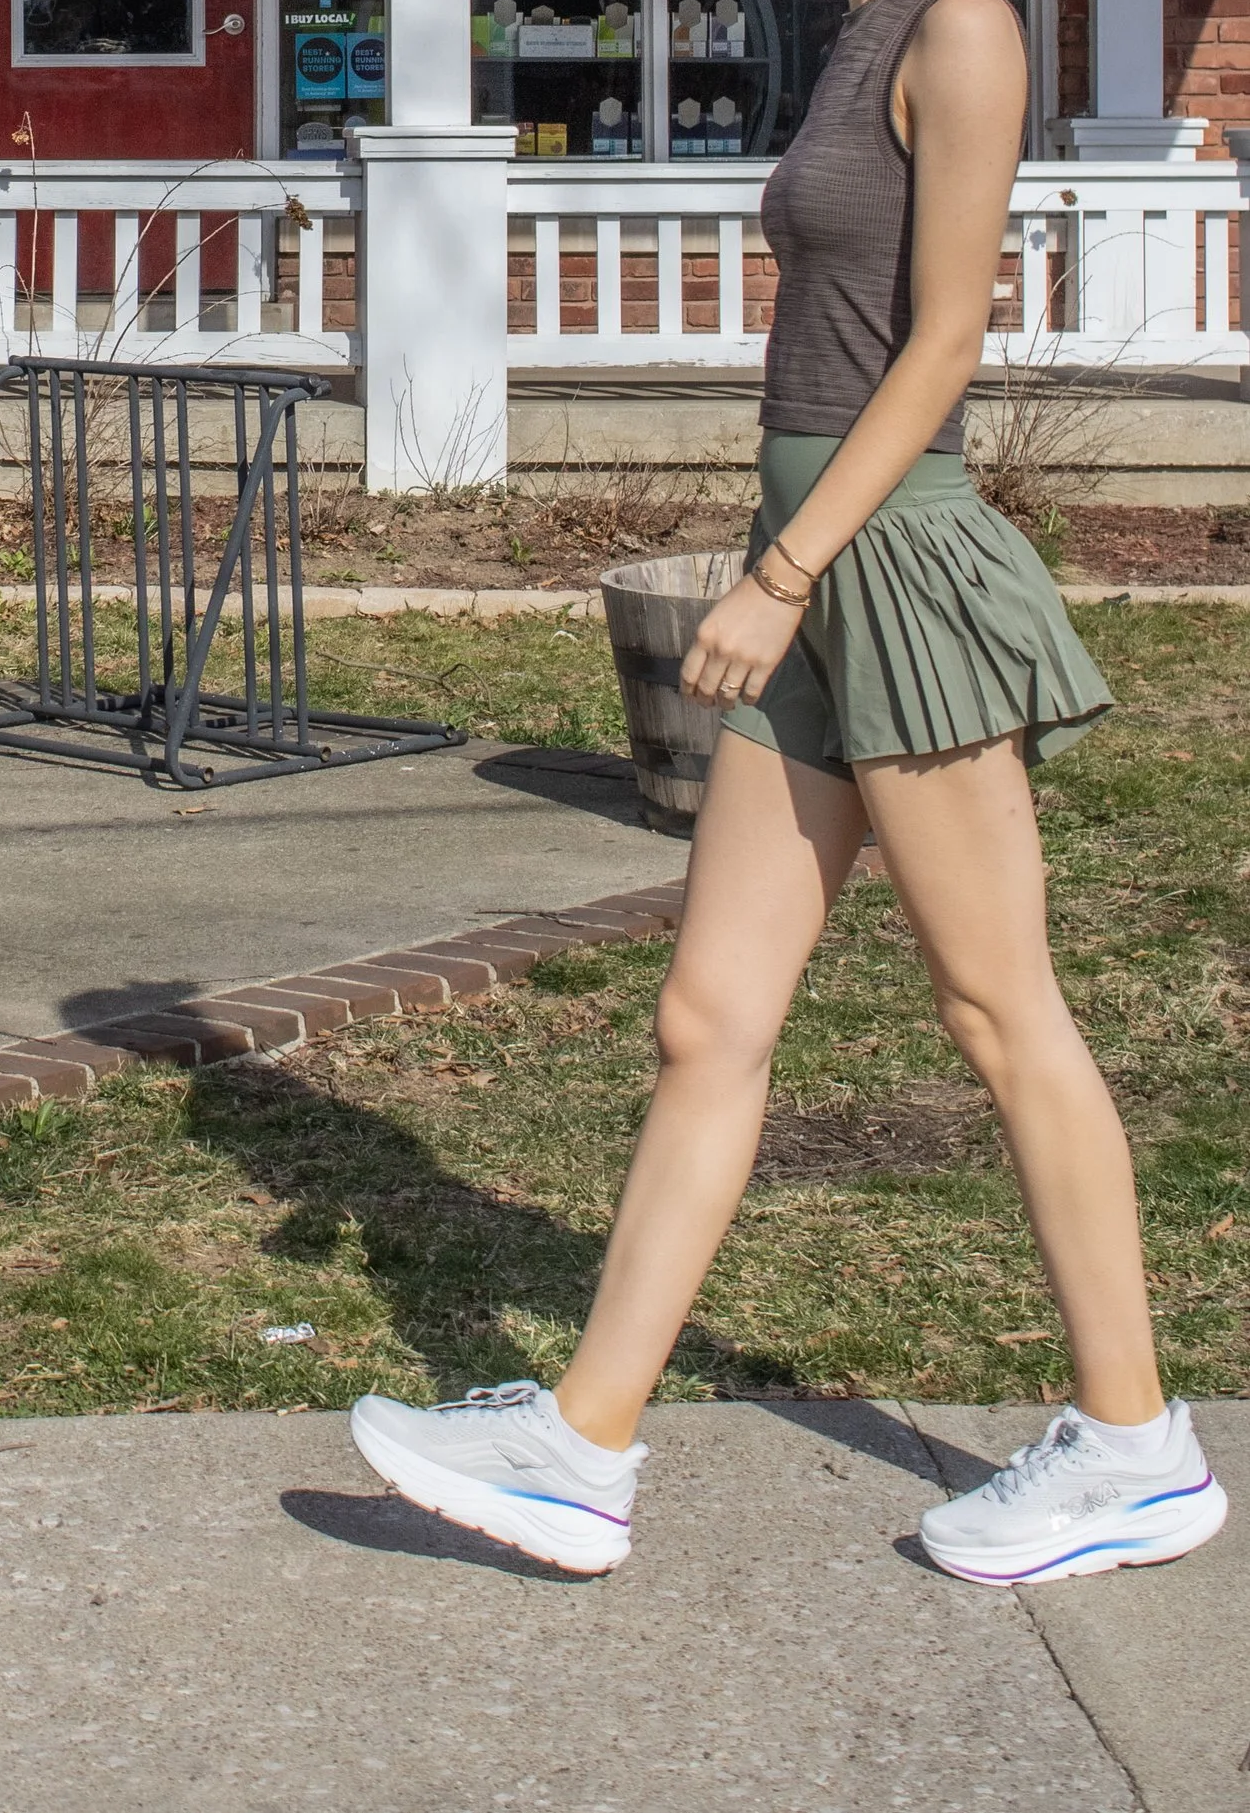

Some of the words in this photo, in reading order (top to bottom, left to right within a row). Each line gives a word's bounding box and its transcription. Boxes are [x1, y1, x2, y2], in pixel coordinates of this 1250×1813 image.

[285, 15, 290, 25] I
[291, 15, 314, 25] BUY
[315, 13, 356, 26] LOCAL!
[302, 56, 341, 64] RUNNING
[302, 64, 335, 72] STORES
[1047, 1480, 1121, 1531] HOKA
